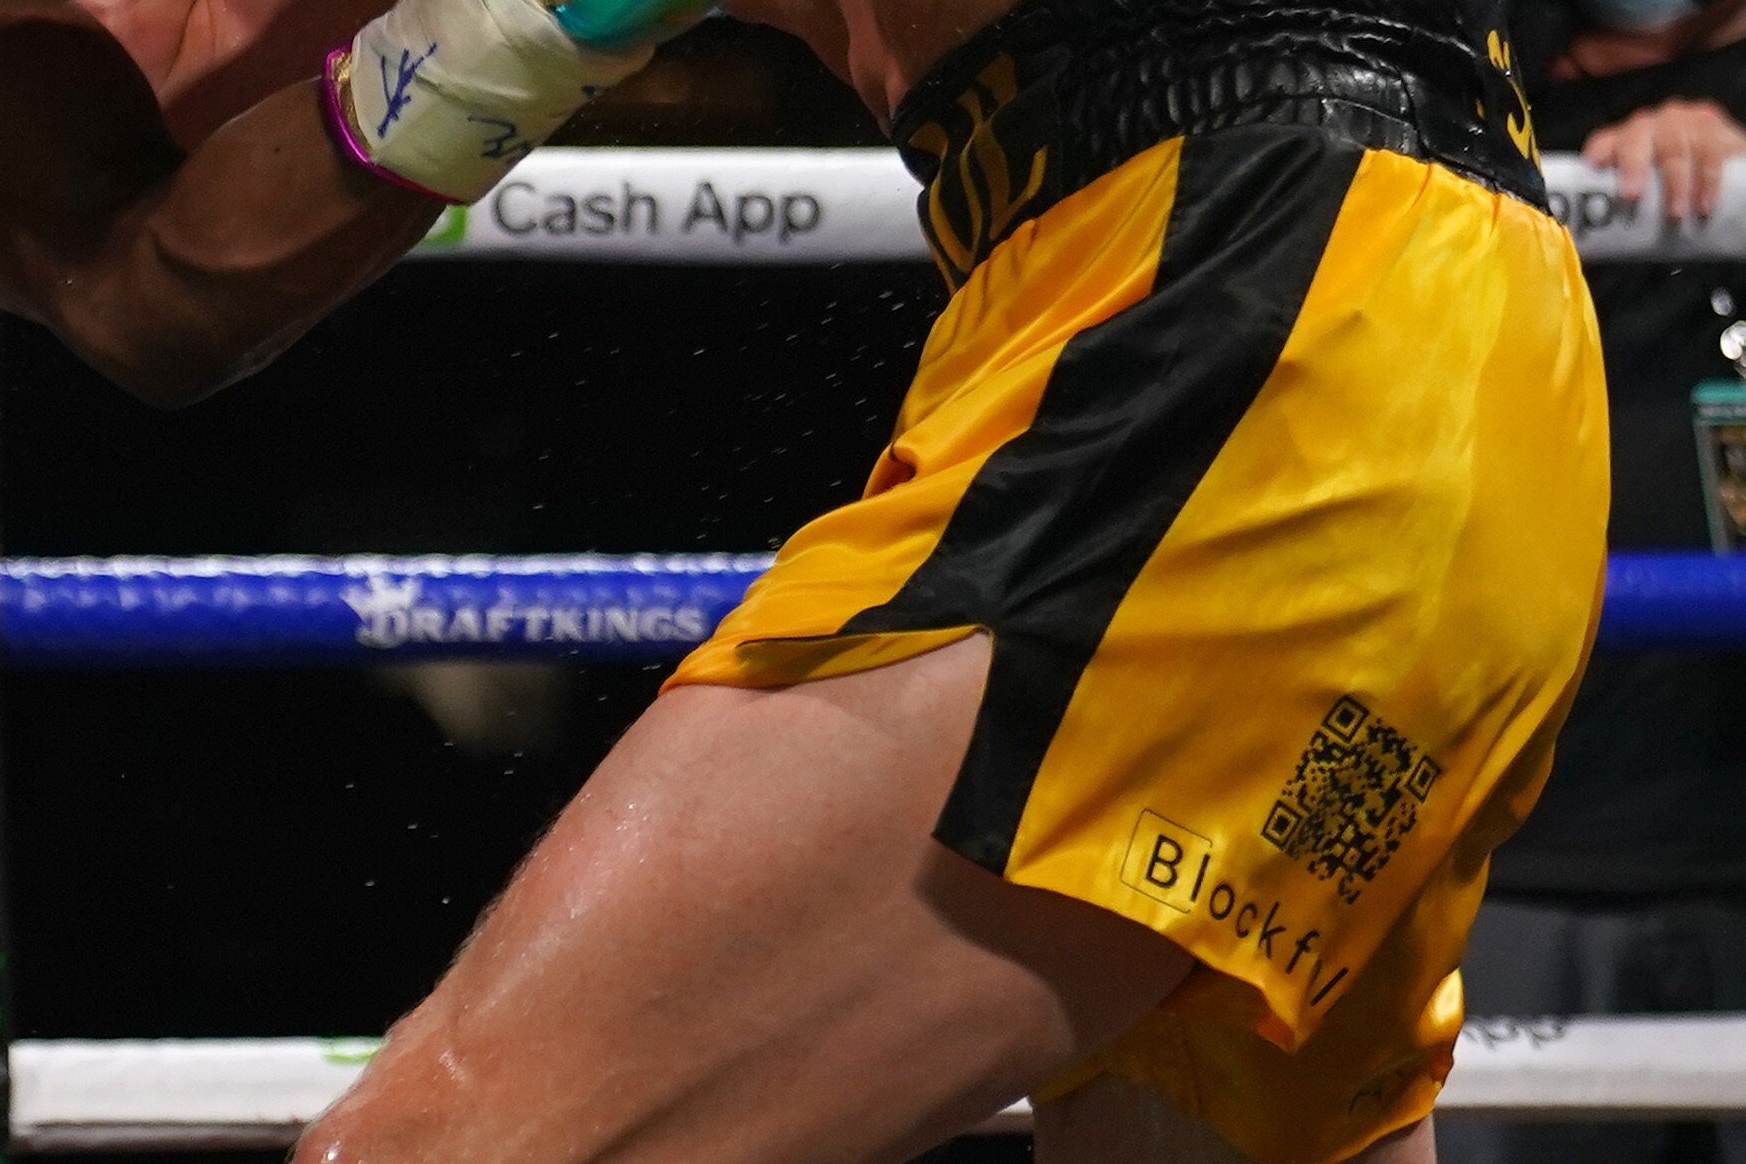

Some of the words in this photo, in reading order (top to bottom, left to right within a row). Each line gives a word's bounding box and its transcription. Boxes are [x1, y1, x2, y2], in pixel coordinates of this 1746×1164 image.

[491, 181, 656, 235] Cash
[681, 181, 822, 244] App
[357, 604, 710, 649] DRAFTKINGS
